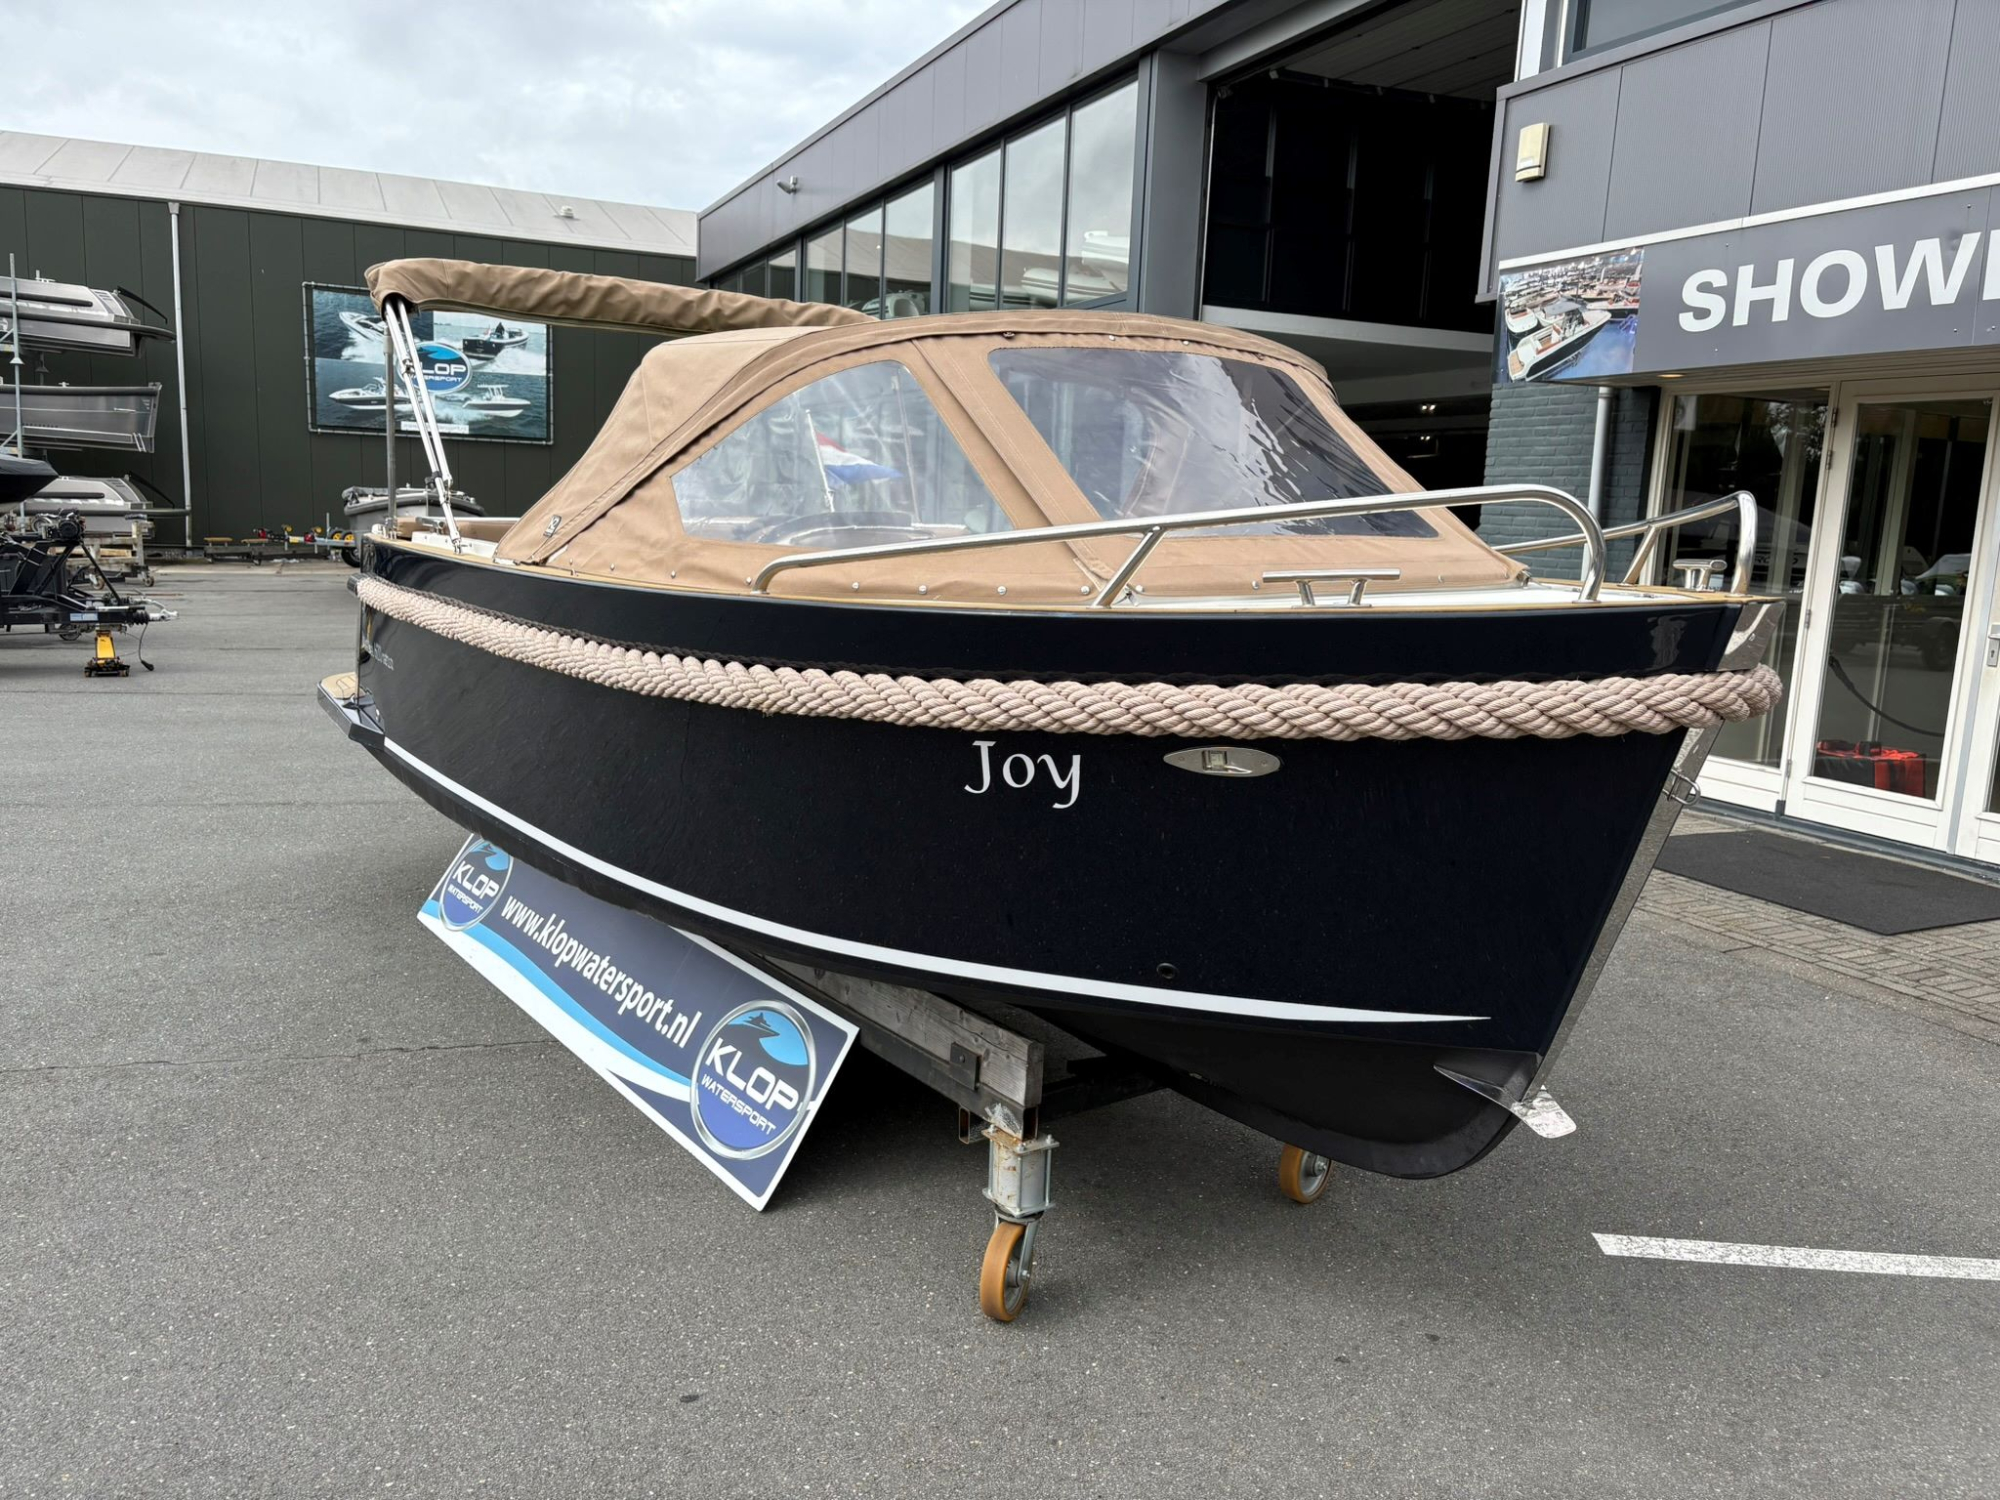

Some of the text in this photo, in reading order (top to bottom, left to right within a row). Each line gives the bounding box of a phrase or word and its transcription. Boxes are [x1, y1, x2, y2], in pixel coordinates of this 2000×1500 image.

[414, 362, 466, 375] LOP
[964, 740, 1081, 809] Joy
[447, 884, 483, 913] WATERSPORT
[452, 860, 499, 899] KLOP
[501, 895, 703, 1049] www.klopwatersport.nl
[701, 1073, 777, 1135] WATERSPORT
[705, 1037, 799, 1111] KLOP
